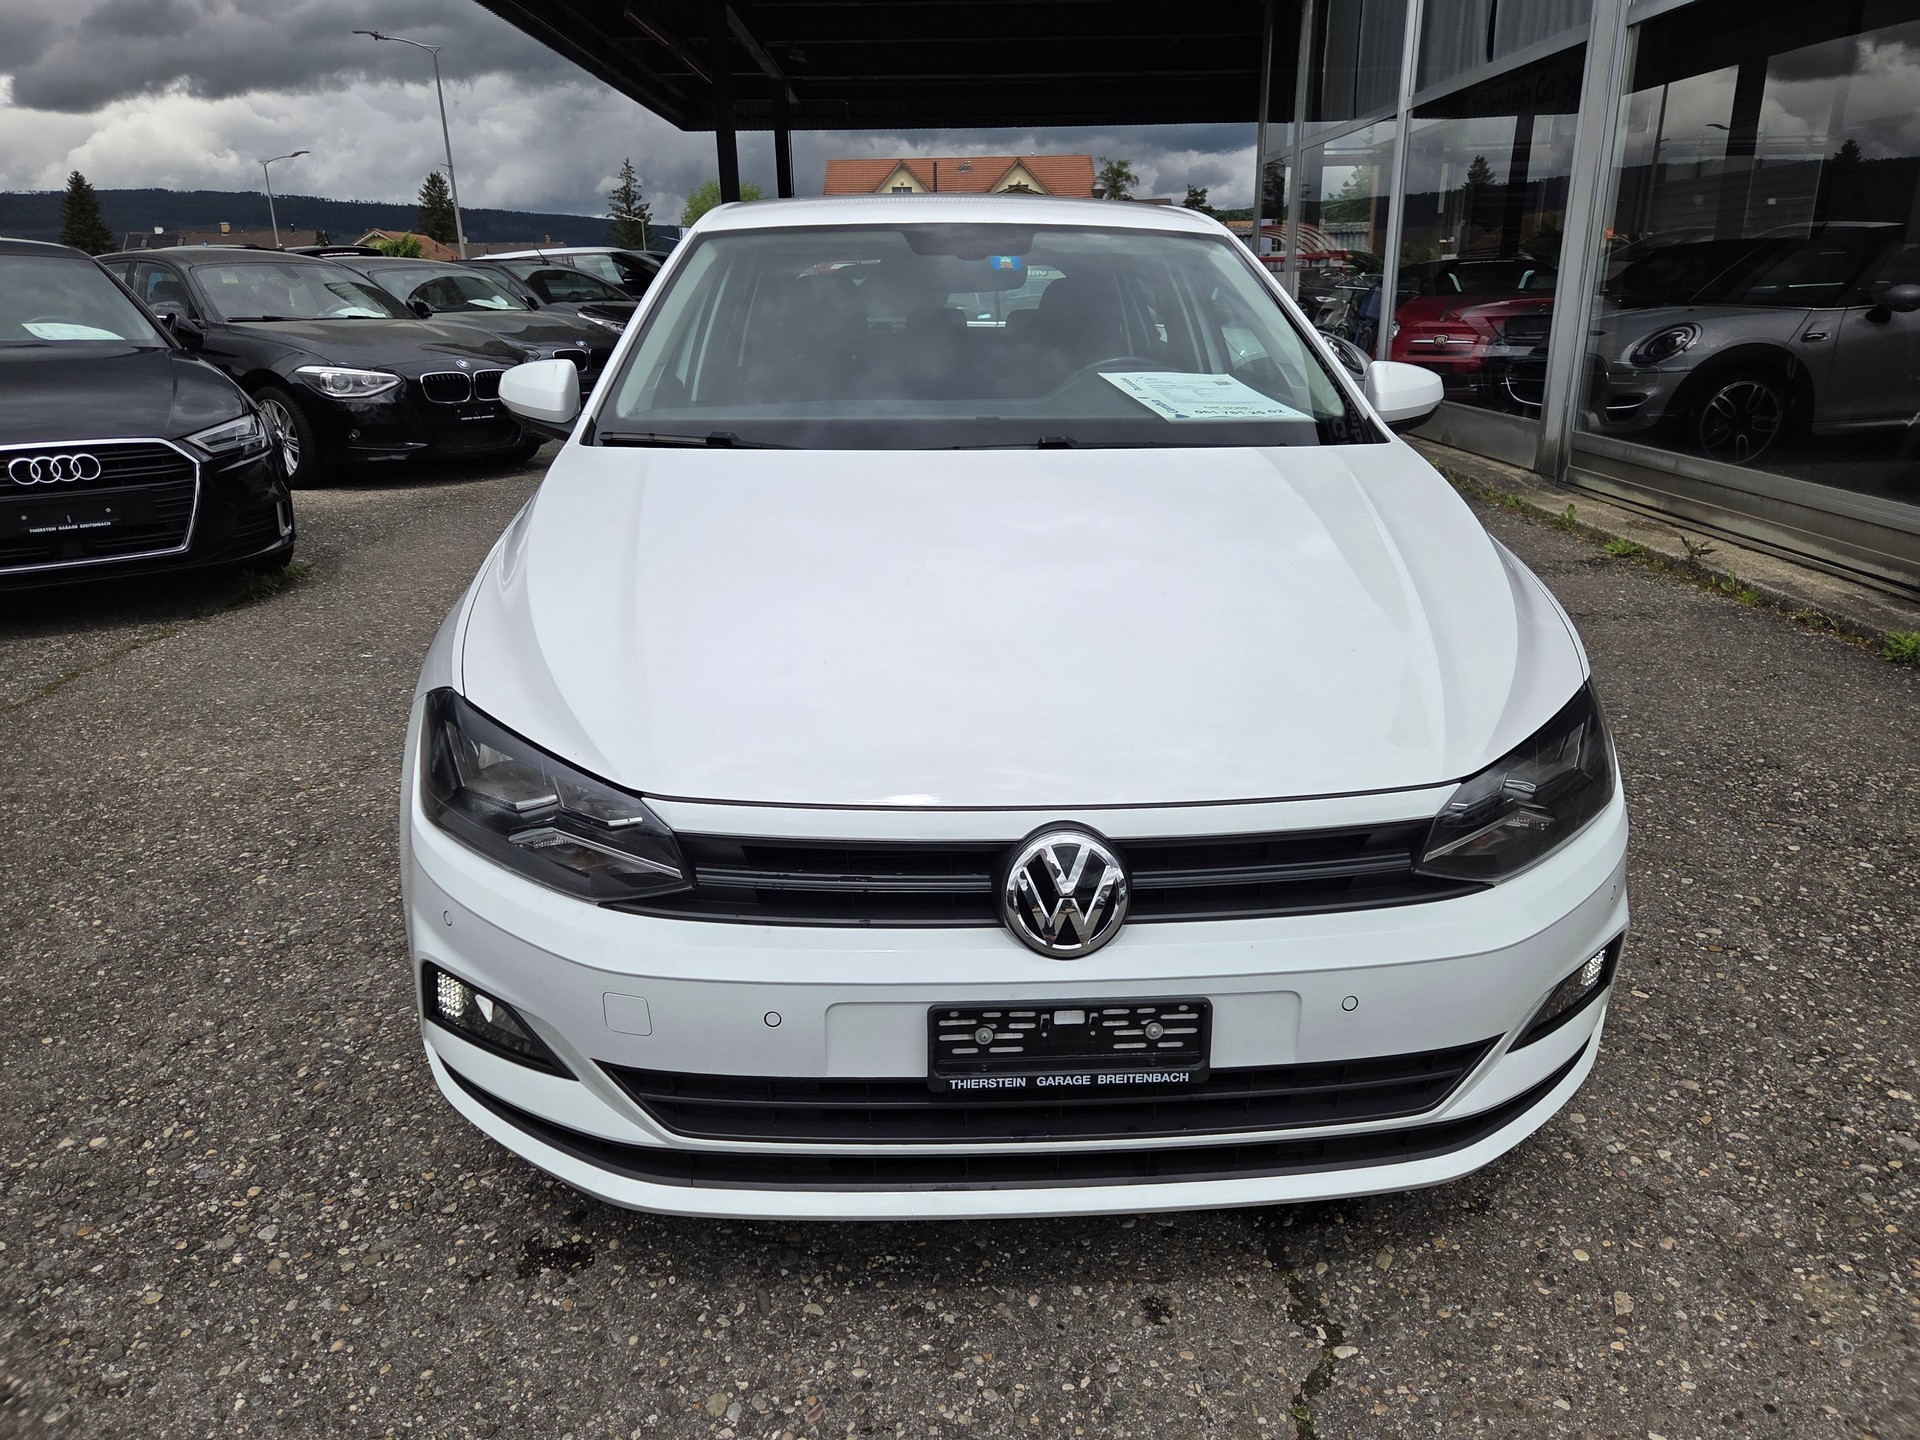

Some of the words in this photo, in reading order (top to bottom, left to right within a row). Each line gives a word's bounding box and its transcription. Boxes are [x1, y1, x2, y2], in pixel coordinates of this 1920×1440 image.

[950, 1076, 1026, 1090] THIERSTEIN
[1036, 1074, 1091, 1087] GARAGE
[1097, 1072, 1190, 1085] BREITENBACH
